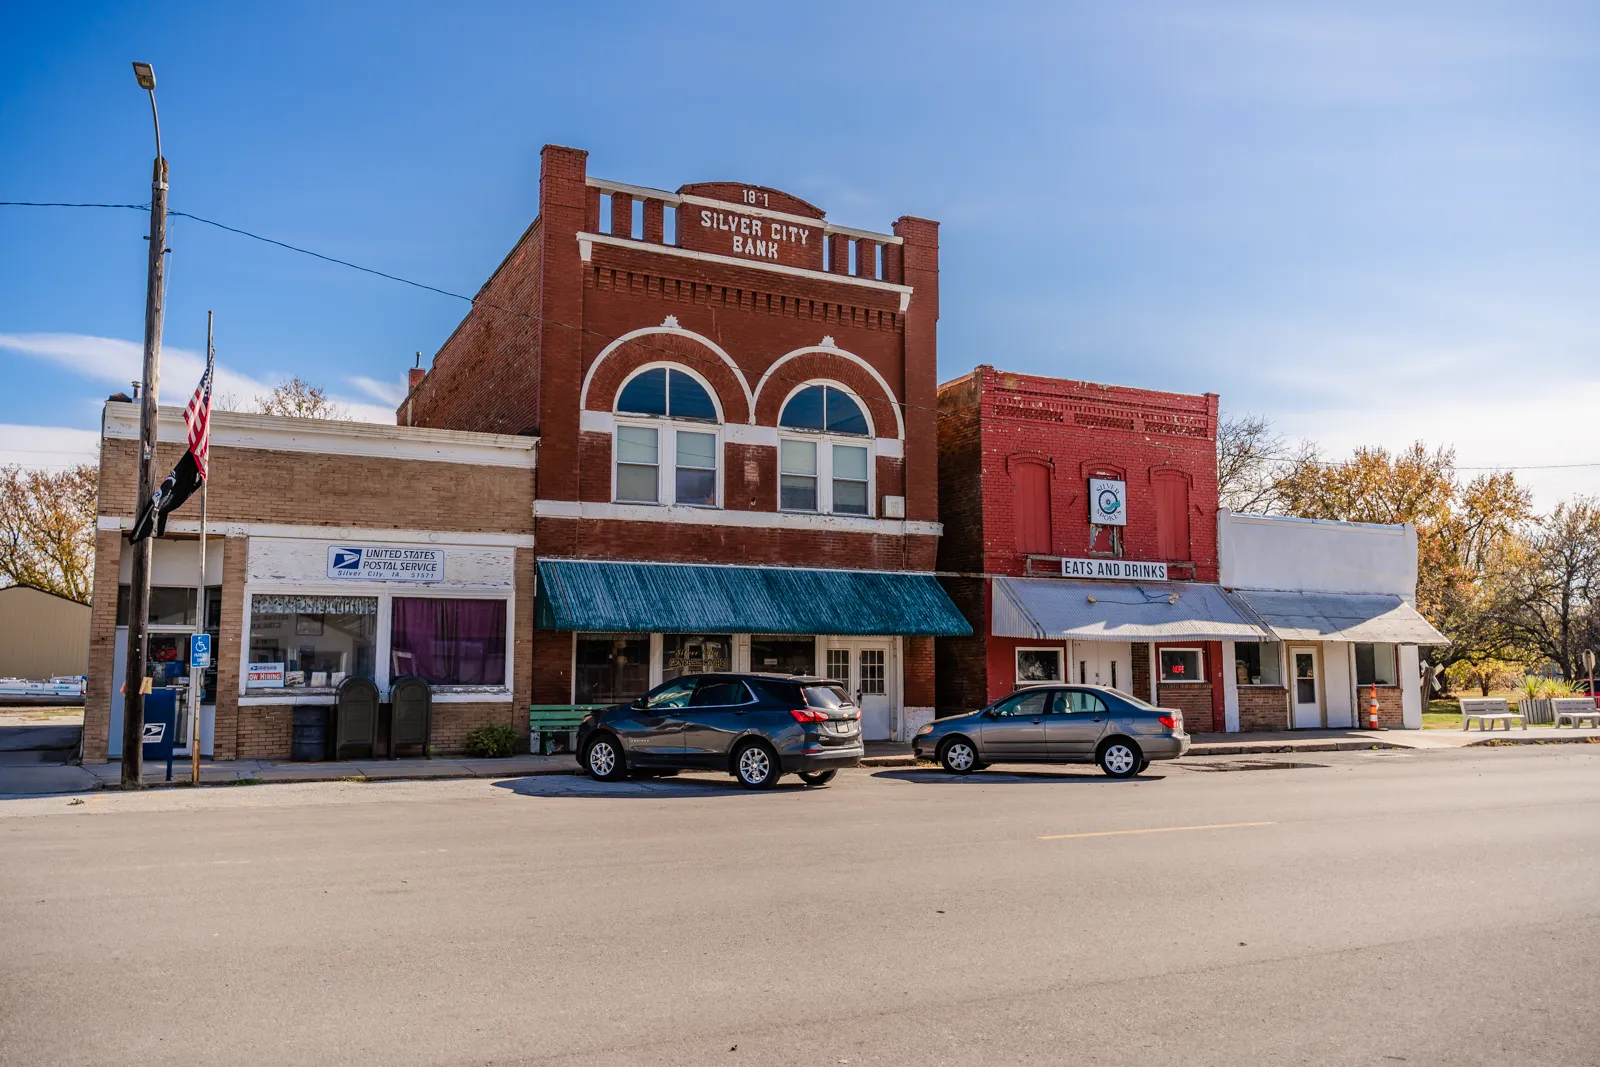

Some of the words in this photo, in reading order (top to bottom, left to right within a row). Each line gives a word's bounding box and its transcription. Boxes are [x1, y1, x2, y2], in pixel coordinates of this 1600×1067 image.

[700, 210, 762, 237] SILVER
[771, 223, 809, 245] CITY
[733, 236, 779, 259] BANK
[366, 549, 401, 559] UNITED
[403, 550, 435, 560] STATES
[363, 561, 398, 571] POSTAL
[400, 562, 438, 572] SERVICE
[1065, 560, 1093, 575] EATS
[1097, 563, 1120, 576] AND
[1125, 564, 1165, 579] DRINKS
